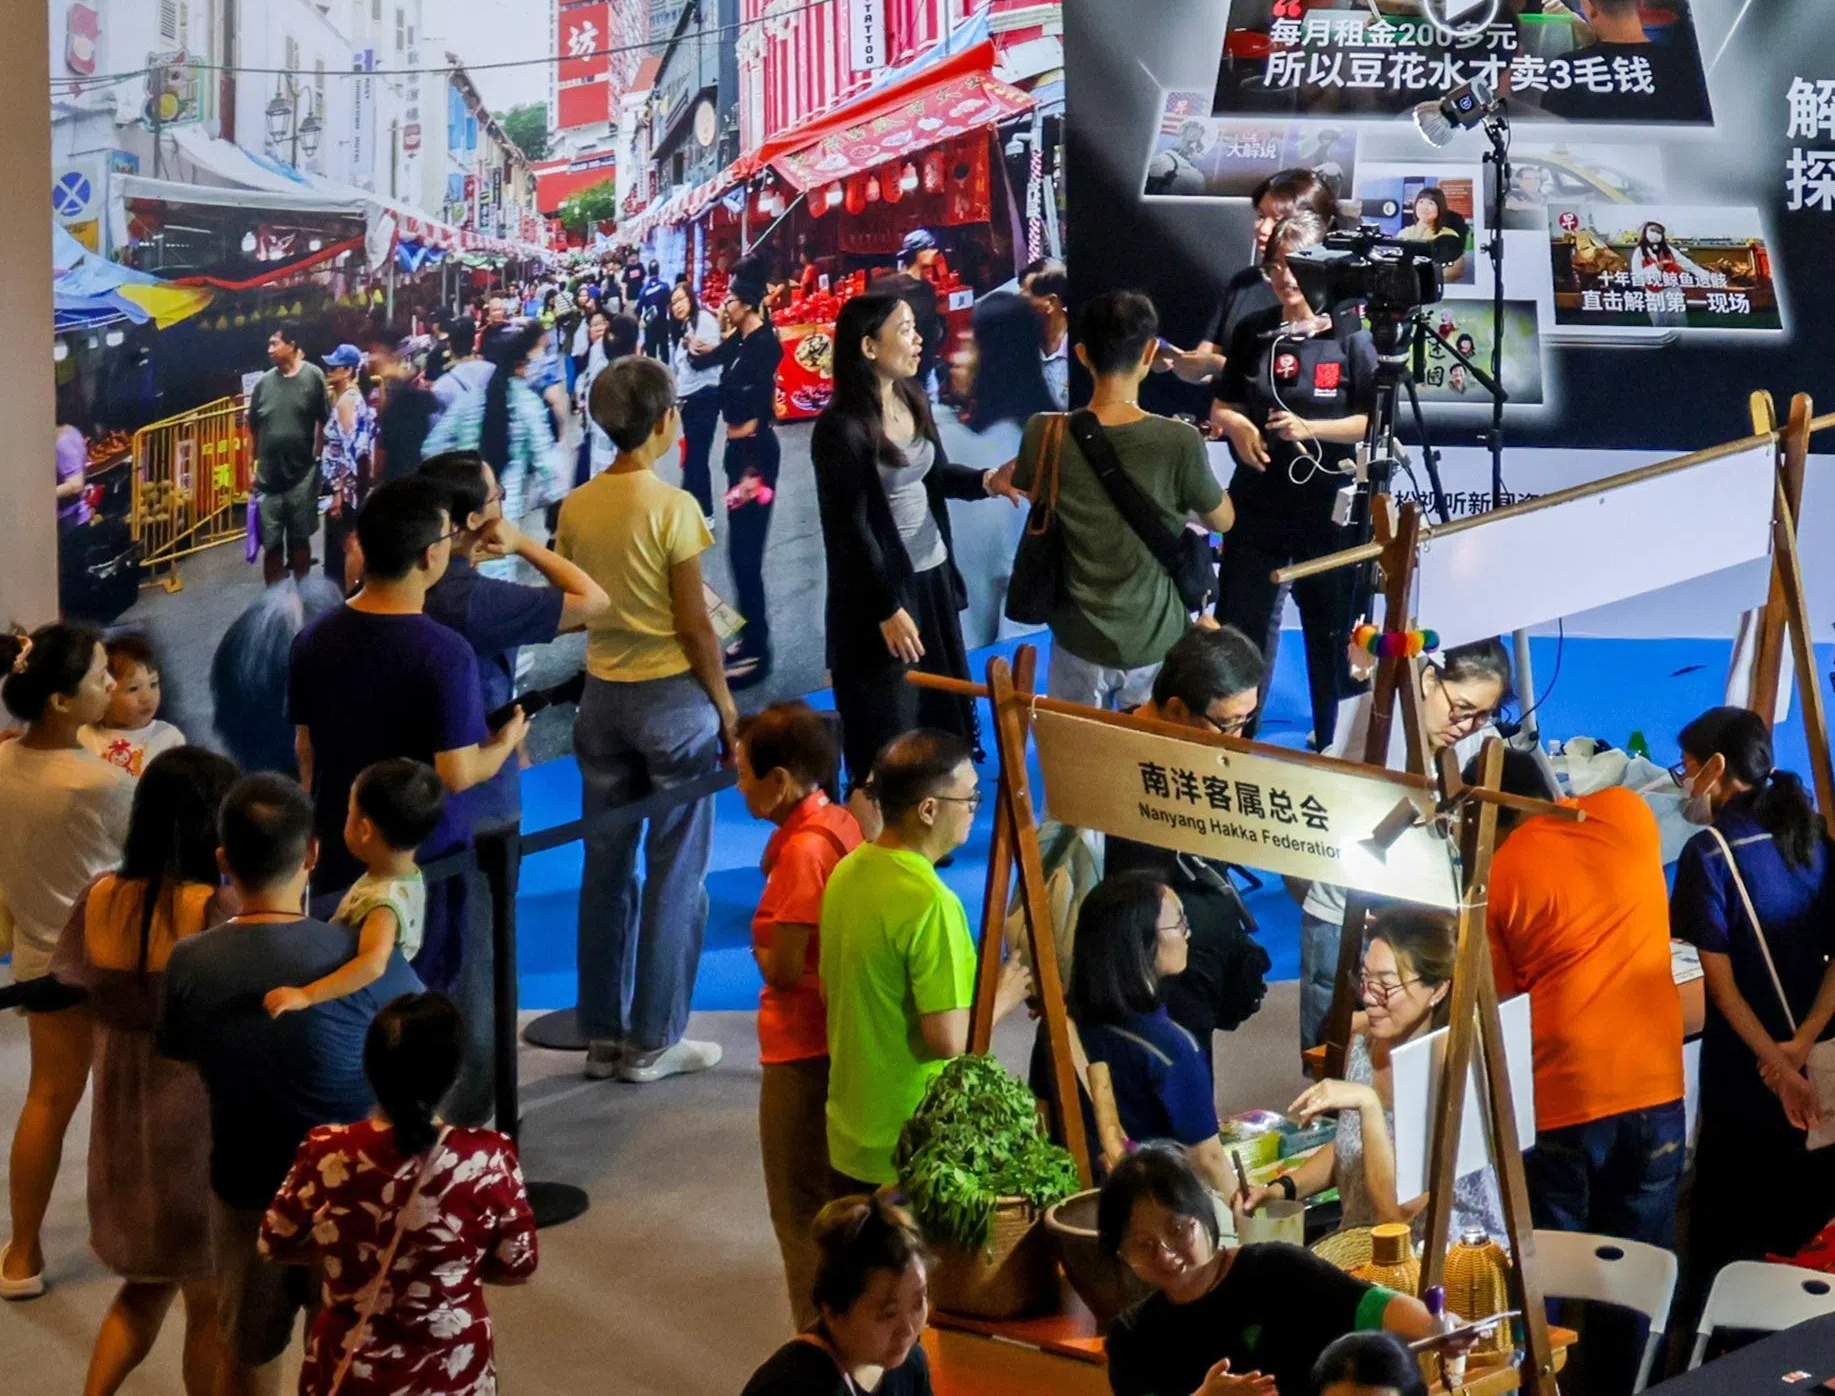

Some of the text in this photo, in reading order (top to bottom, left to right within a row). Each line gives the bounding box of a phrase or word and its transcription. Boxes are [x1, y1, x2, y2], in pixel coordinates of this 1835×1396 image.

[863, 3, 876, 66] TATTOO
[1269, 18, 1519, 52] 每月租金200多元
[1263, 51, 1657, 96] 所以豆花水才卖3毛钱
[1561, 212, 1577, 231] 早
[1597, 271, 1728, 288] 十年首现鲸鱼遗骸
[1581, 290, 1751, 315] 直击解剖第一现场
[1277, 354, 1297, 379] 早
[1137, 760, 1331, 833] 南洋客属总会
[1137, 801, 1343, 860] Nanyang Hakka Federation
